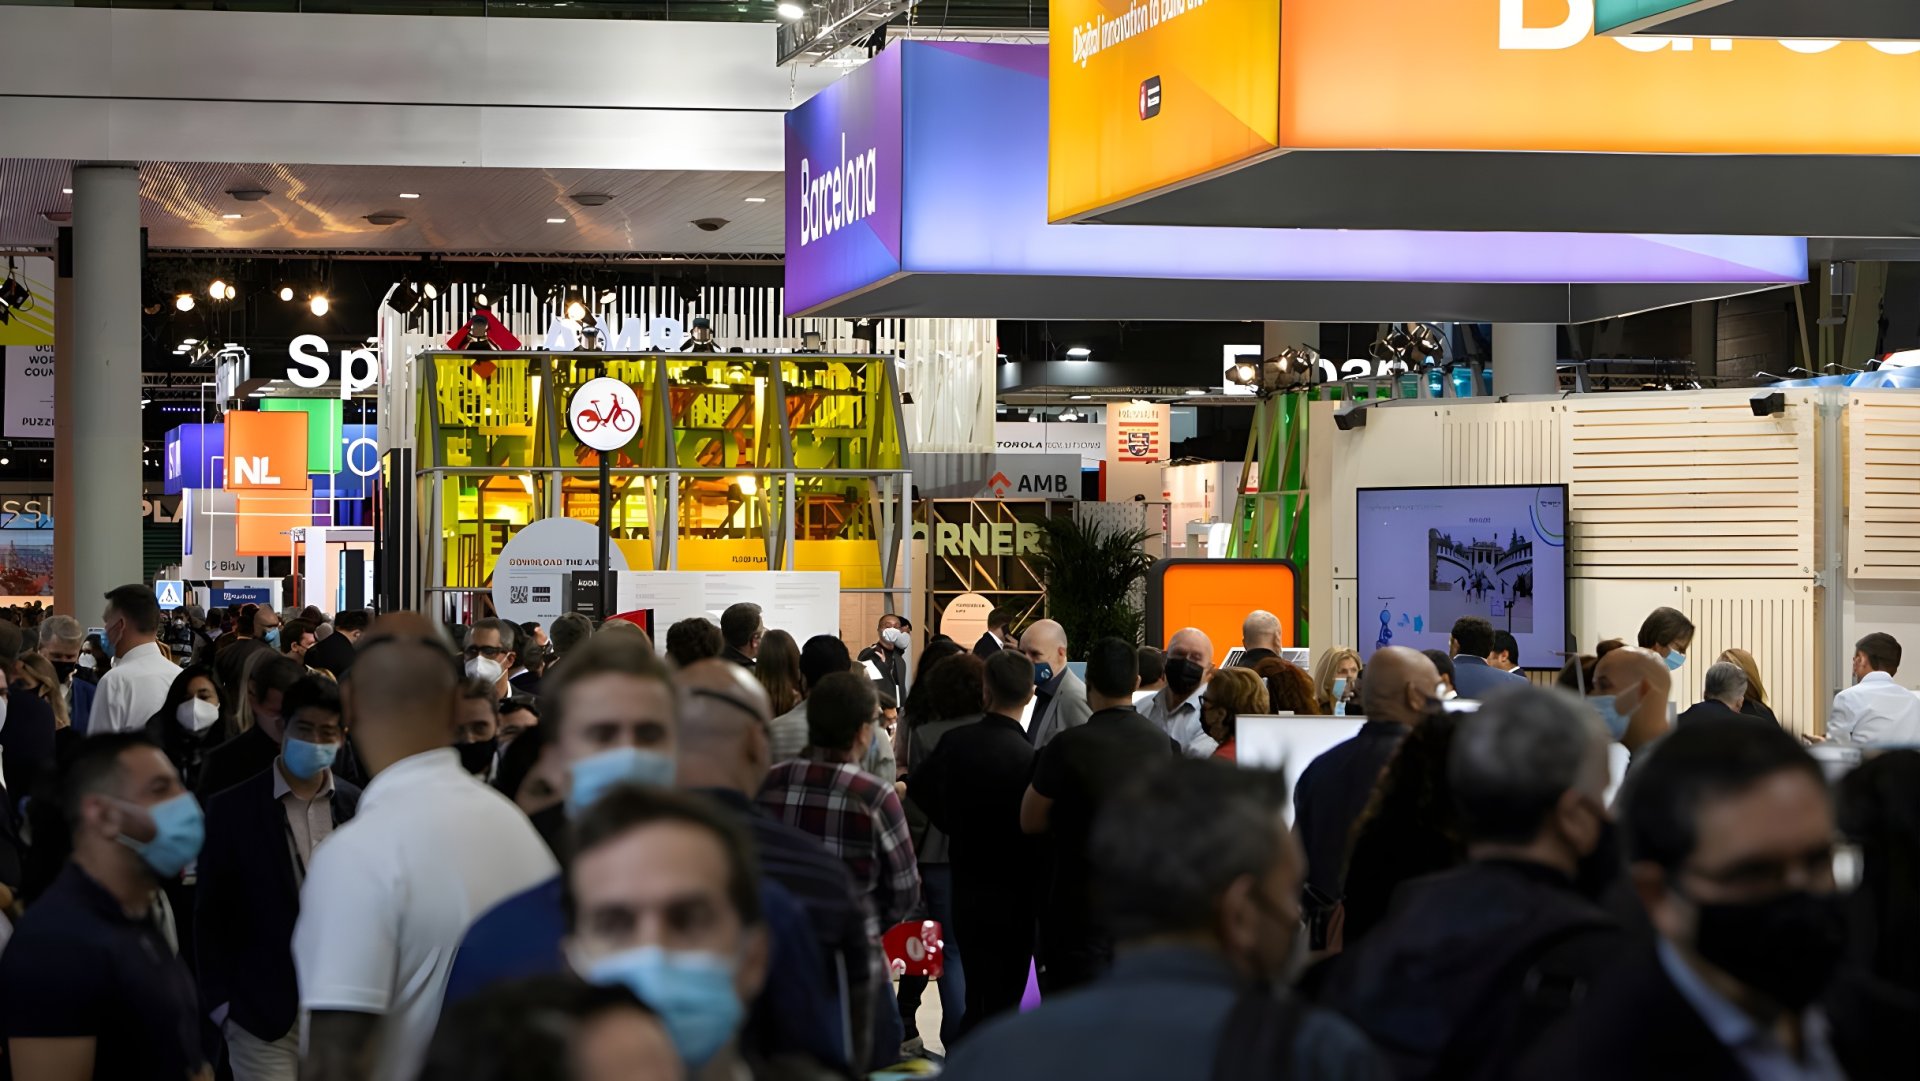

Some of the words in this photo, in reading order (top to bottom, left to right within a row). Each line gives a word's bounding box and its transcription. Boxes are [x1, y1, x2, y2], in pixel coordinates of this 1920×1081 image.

[1149, 0, 1159, 28] to
[801, 132, 876, 246] Barcelona
[235, 456, 280, 485] NL
[1017, 474, 1068, 493] AMB
